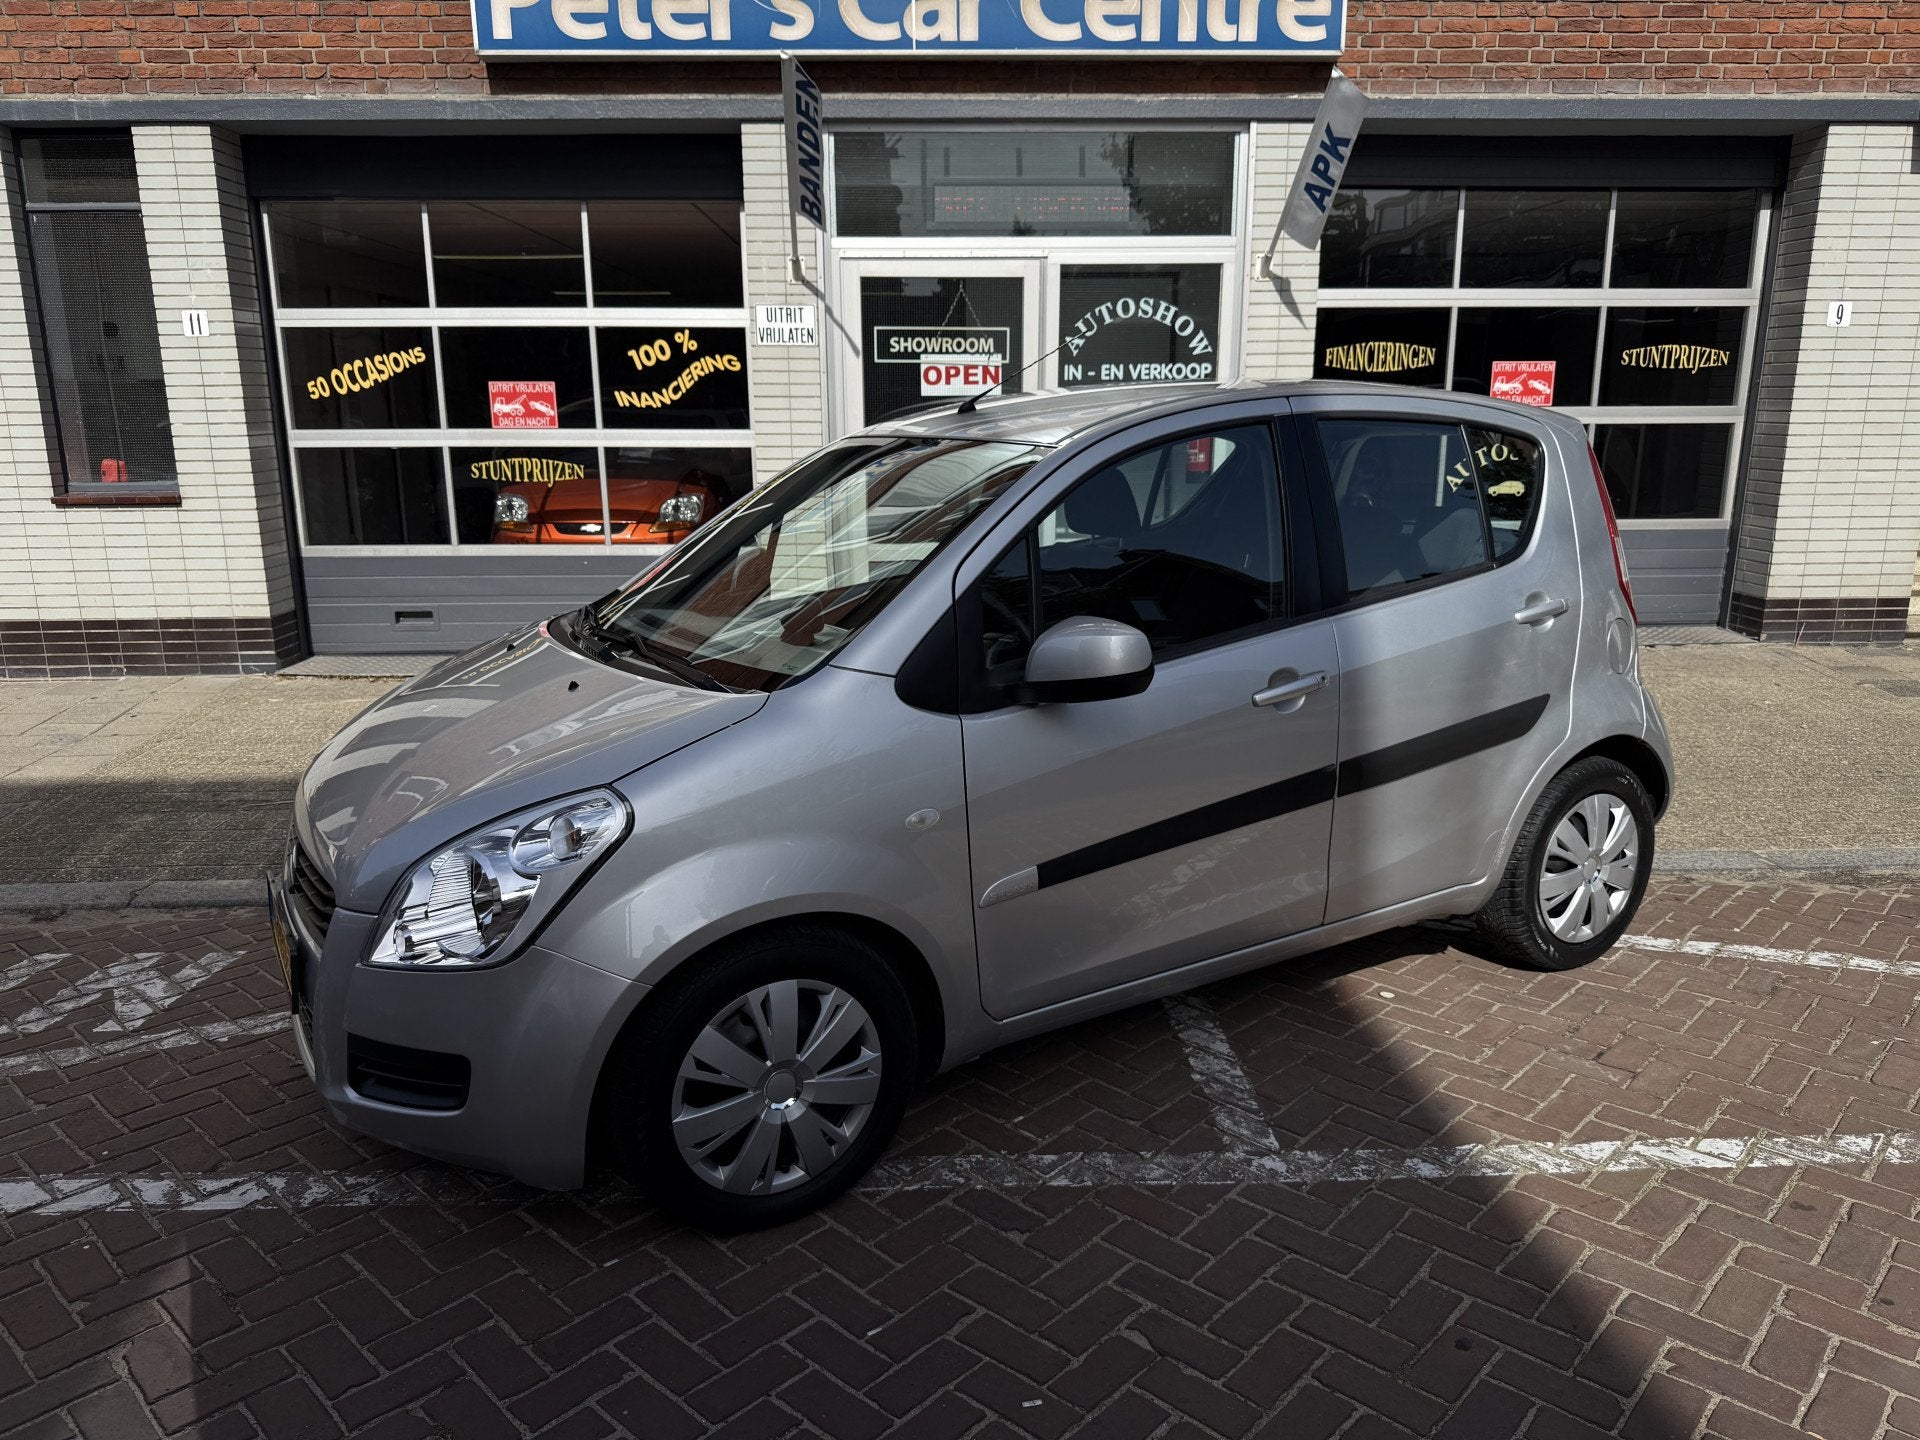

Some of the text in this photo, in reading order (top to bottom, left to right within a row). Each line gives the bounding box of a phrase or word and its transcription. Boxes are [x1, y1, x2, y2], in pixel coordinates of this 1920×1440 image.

[491, 0, 814, 41] eters
[796, 63, 823, 226] BANDEN
[1303, 121, 1352, 214] APK
[189, 313, 202, 335] 11
[766, 307, 804, 323] UITRIT
[1836, 304, 1844, 325] 9
[758, 327, 814, 343] VRIJLATEN
[1064, 297, 1213, 357] AUTOSHOW
[627, 329, 698, 371] 100 %
[889, 336, 995, 353] SHOWROOM
[1324, 341, 1436, 373] FINANCIERINGEN
[1494, 363, 1553, 372] UITRIT VRIJLATEN
[1620, 344, 1730, 375] STUNTPRIJZEN
[307, 346, 427, 399] 50 OCCASIONS
[614, 354, 742, 409] INANCIERING
[922, 365, 1000, 386] OPEN
[1064, 363, 1082, 381] IN
[1100, 363, 1124, 381] EN
[1129, 362, 1213, 380] VERKOOP
[490, 384, 554, 393] UITRIT VRIJLATEN
[1522, 395, 1546, 404] NACHT
[498, 417, 551, 426] DAG EN NACHT
[471, 458, 585, 487] STUNTPRIJZEN
